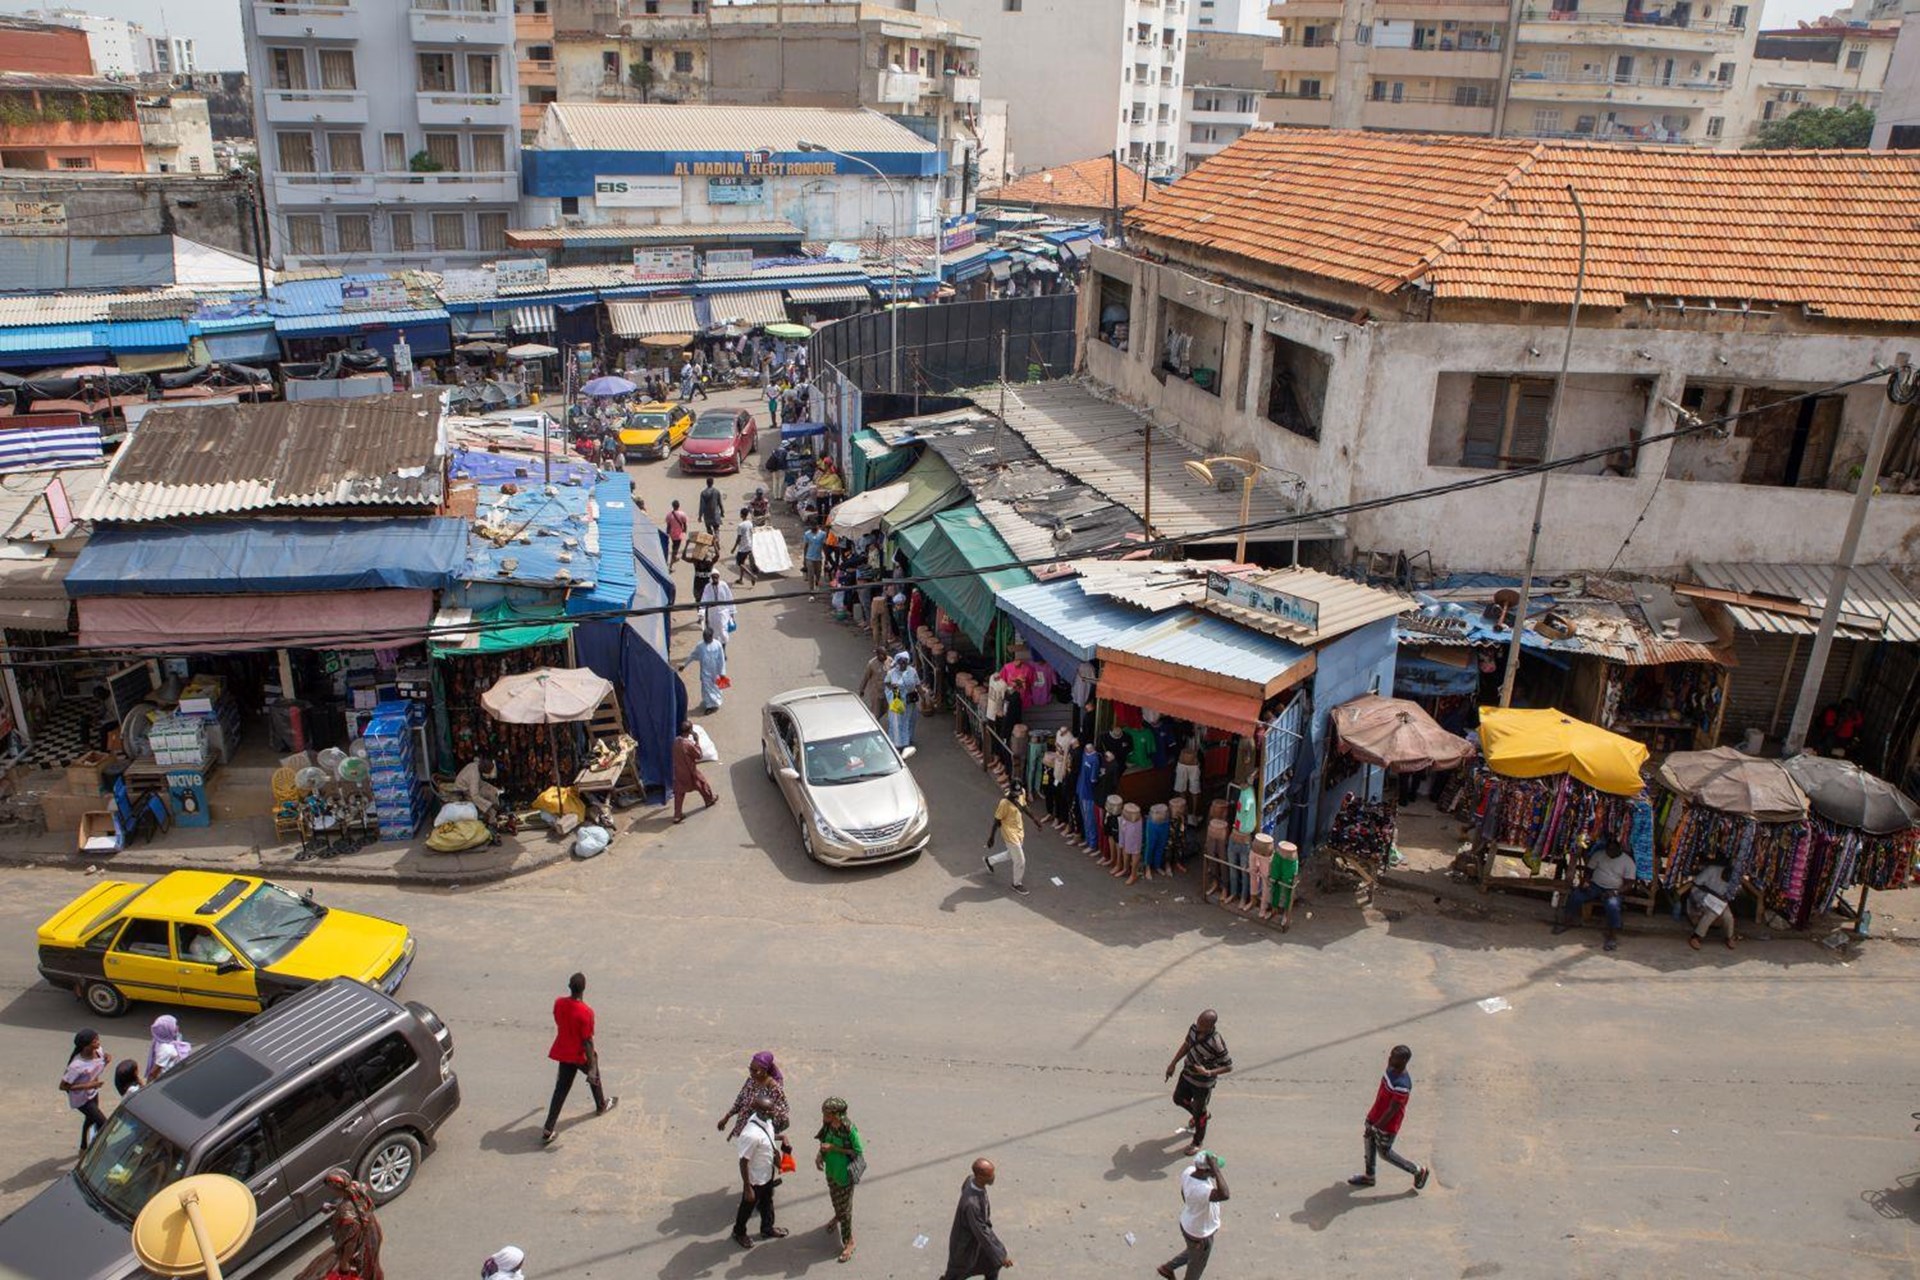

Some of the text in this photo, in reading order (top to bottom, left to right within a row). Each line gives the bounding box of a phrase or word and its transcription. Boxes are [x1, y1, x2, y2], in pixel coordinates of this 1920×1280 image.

[674, 162, 689, 176] AL
[693, 162, 744, 176] MADINA
[596, 182, 628, 193] EIS
[166, 774, 203, 787] wave
